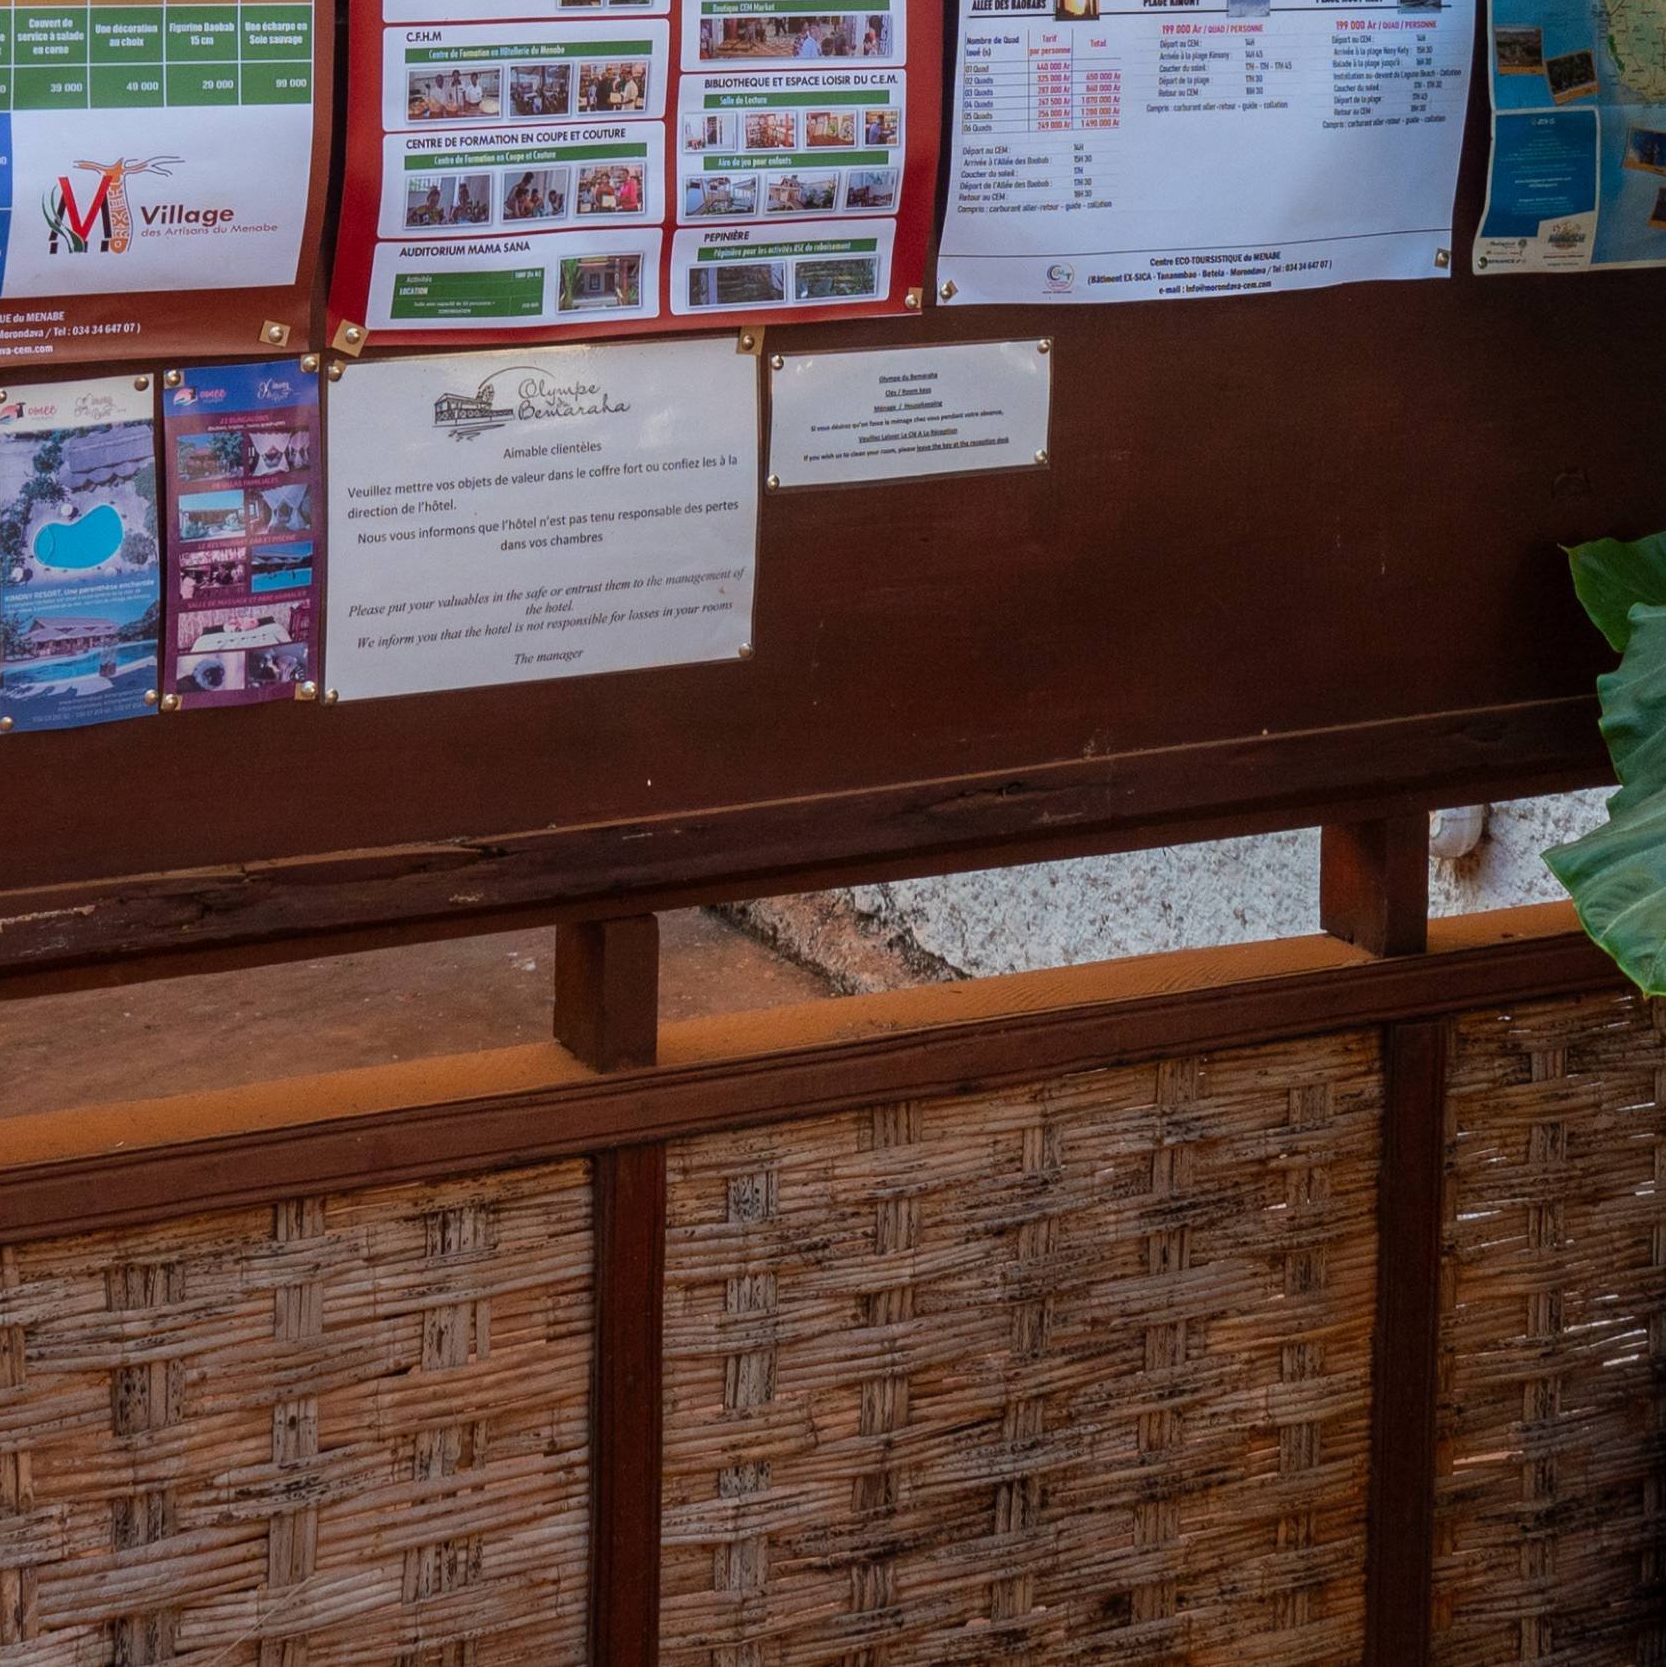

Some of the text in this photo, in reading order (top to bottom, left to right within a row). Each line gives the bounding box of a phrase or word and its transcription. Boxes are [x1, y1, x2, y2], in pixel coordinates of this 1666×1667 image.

[704, 74, 898, 88] BIBLIOTHEQUE ET ESPACE LOISIR DU C.E.M.
[406, 128, 625, 149] CENTRE DE FORMATION EN COUPE ET COUTURE
[141, 205, 235, 227] Village
[141, 223, 277, 237] des Artisans du Menabe
[399, 241, 530, 257] AUDITORIUM MAMA SANA
[518, 379, 601, 406] Olympe
[503, 441, 602, 458] Aimable clientèles
[347, 454, 737, 498] Veuillez mettre vos objets de valeur dans le coffre fort ou confiez les à la
[347, 498, 456, 518] direction de l'hôtel.
[358, 501, 738, 543] Nous vous informons que l'hôtel n'est pas tenu responsable des pertes
[500, 533, 602, 550] dans vos chambres
[349, 568, 744, 617] Please put your valuables in the safe or entrust them to the management of
[525, 600, 573, 614] the hotel.
[358, 602, 732, 648] We inform you that the hotel is not responsible for losses in your rooms
[515, 650, 583, 664] The manager
